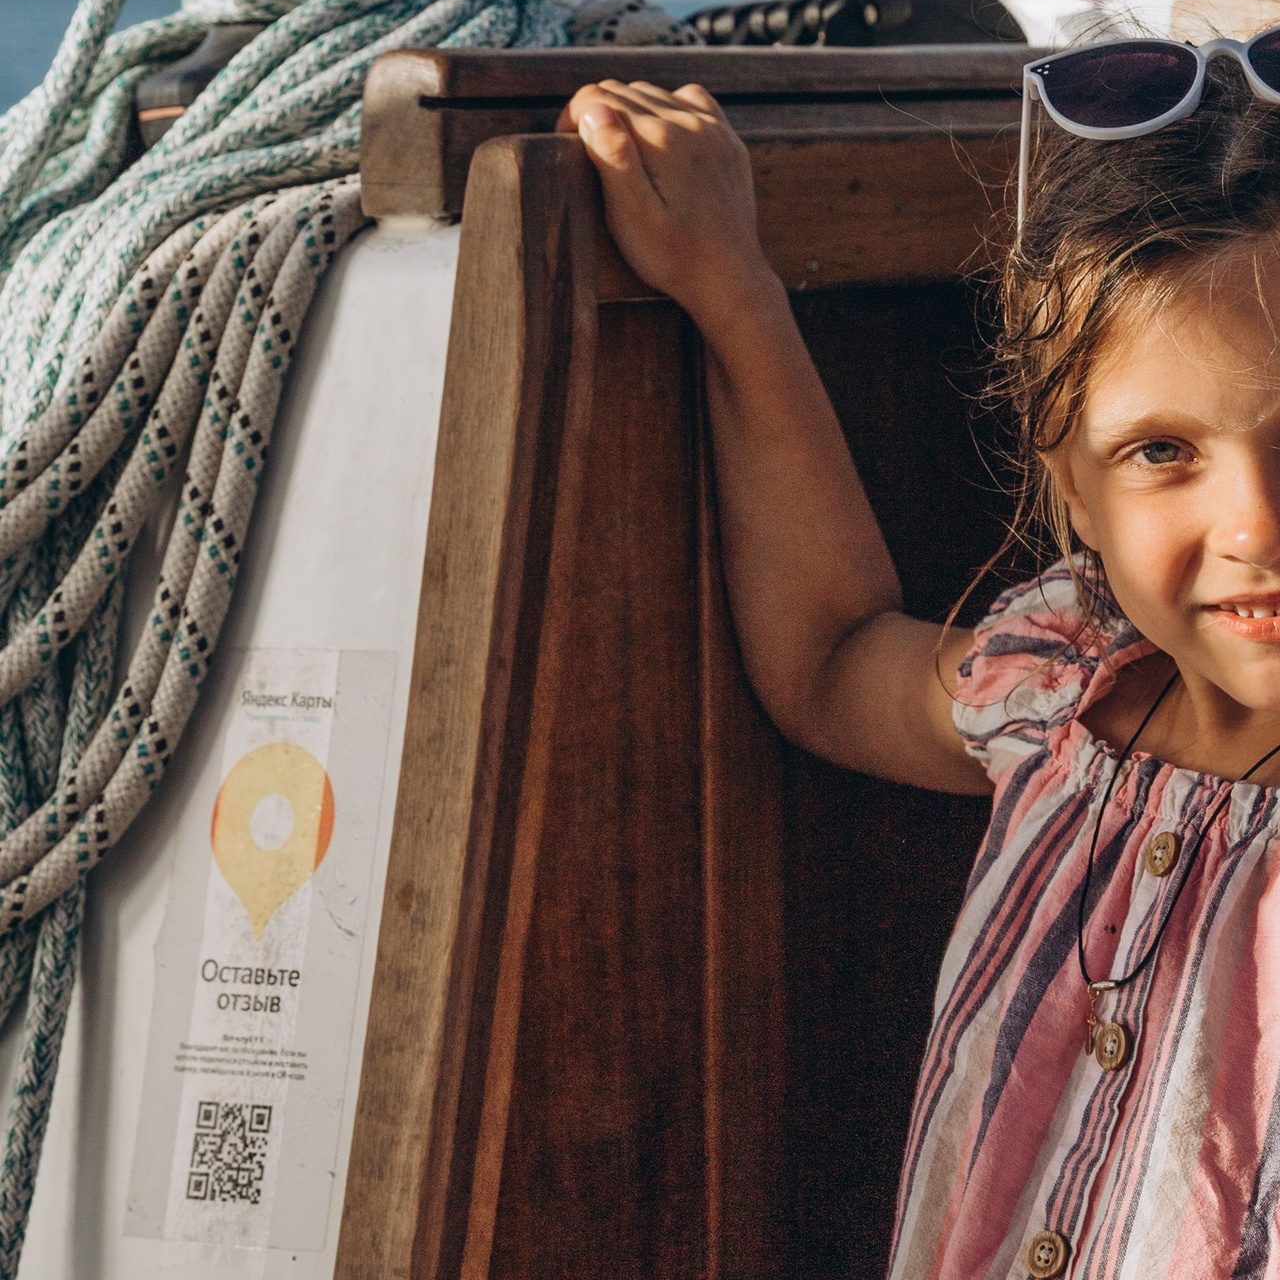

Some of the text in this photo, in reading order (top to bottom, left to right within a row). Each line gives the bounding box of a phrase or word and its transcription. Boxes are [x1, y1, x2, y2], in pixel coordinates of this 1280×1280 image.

[241, 690, 333, 710] Яндекс Карты
[201, 959, 301, 987] Оставьте
[217, 993, 281, 1013] отзыв
